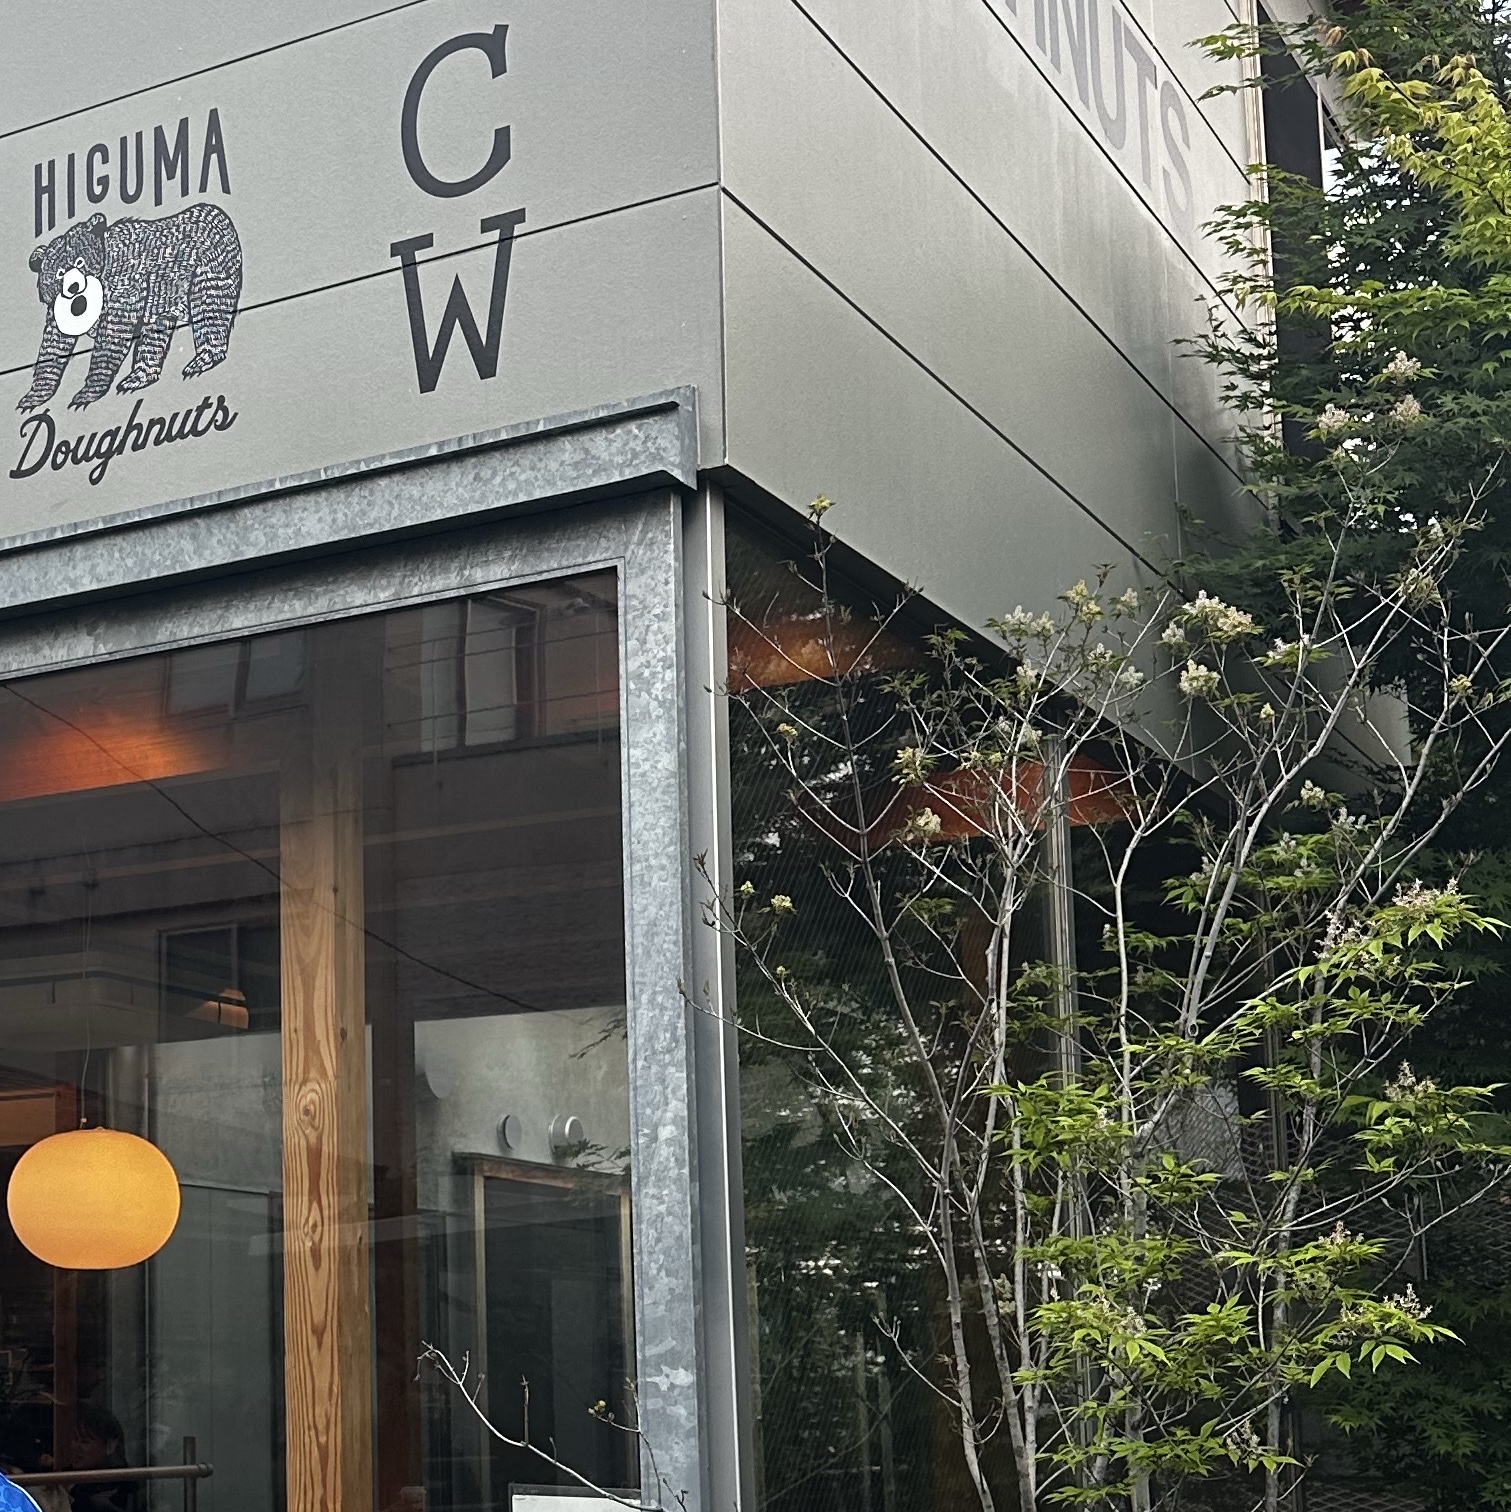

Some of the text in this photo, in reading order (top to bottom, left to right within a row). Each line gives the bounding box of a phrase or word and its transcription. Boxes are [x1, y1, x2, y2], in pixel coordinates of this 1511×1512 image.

[33, 107, 231, 238] HIGUMA
[400, 23, 511, 199] C
[390, 207, 527, 394] W
[9, 394, 238, 486] Doughnuts
